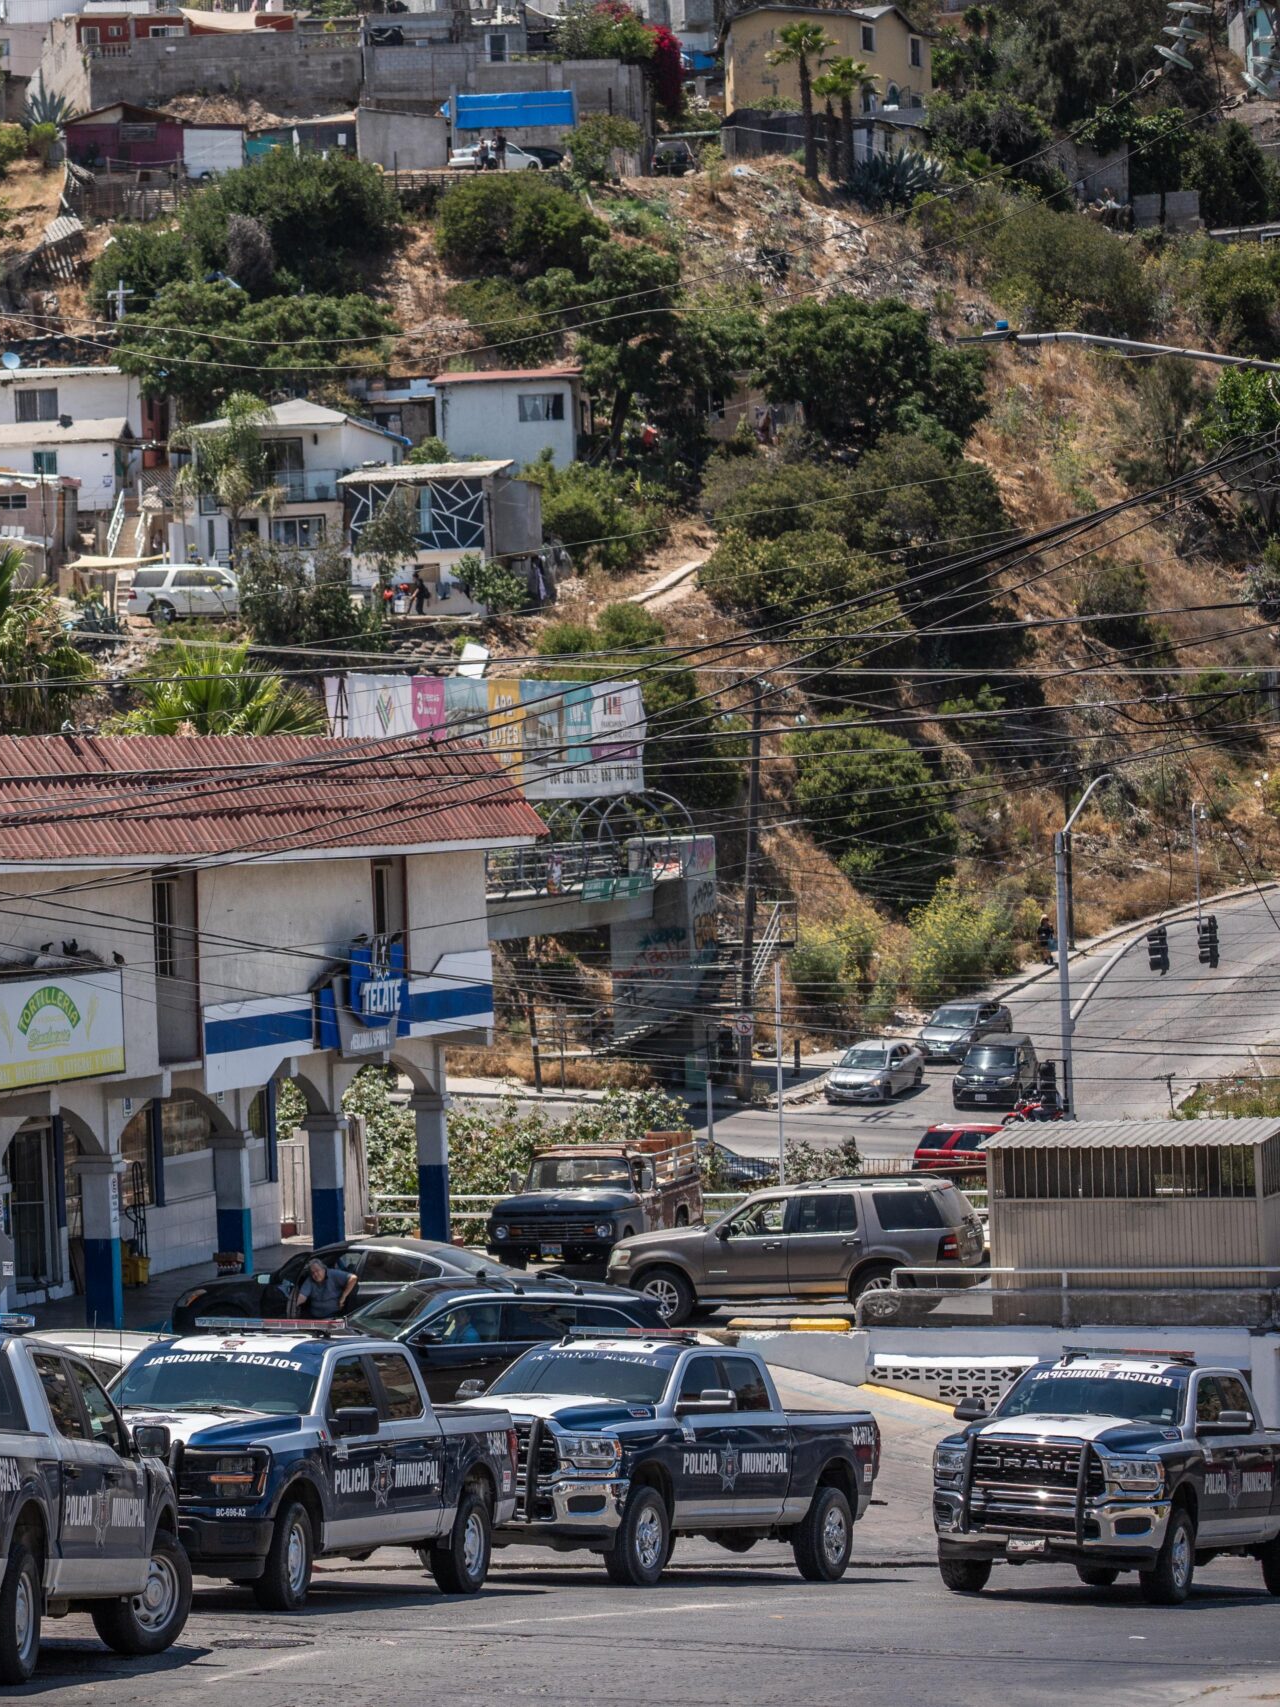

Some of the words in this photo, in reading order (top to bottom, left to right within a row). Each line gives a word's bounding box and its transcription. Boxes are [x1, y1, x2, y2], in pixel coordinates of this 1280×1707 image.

[19, 987, 79, 1031] TORTILLERIA
[360, 979, 402, 1015] TECATE
[334, 1463, 369, 1495] POLICÍA
[394, 1460, 440, 1488] MUNICIPAL
[683, 1450, 718, 1475] POLICÍA
[741, 1452, 789, 1474] MUNICIPAL
[1003, 1458, 1061, 1470] RAM
[1241, 1471, 1272, 1493] MUNICIPAL
[64, 1490, 93, 1526] POLICÍA
[111, 1497, 146, 1527] MUNICIPAL
